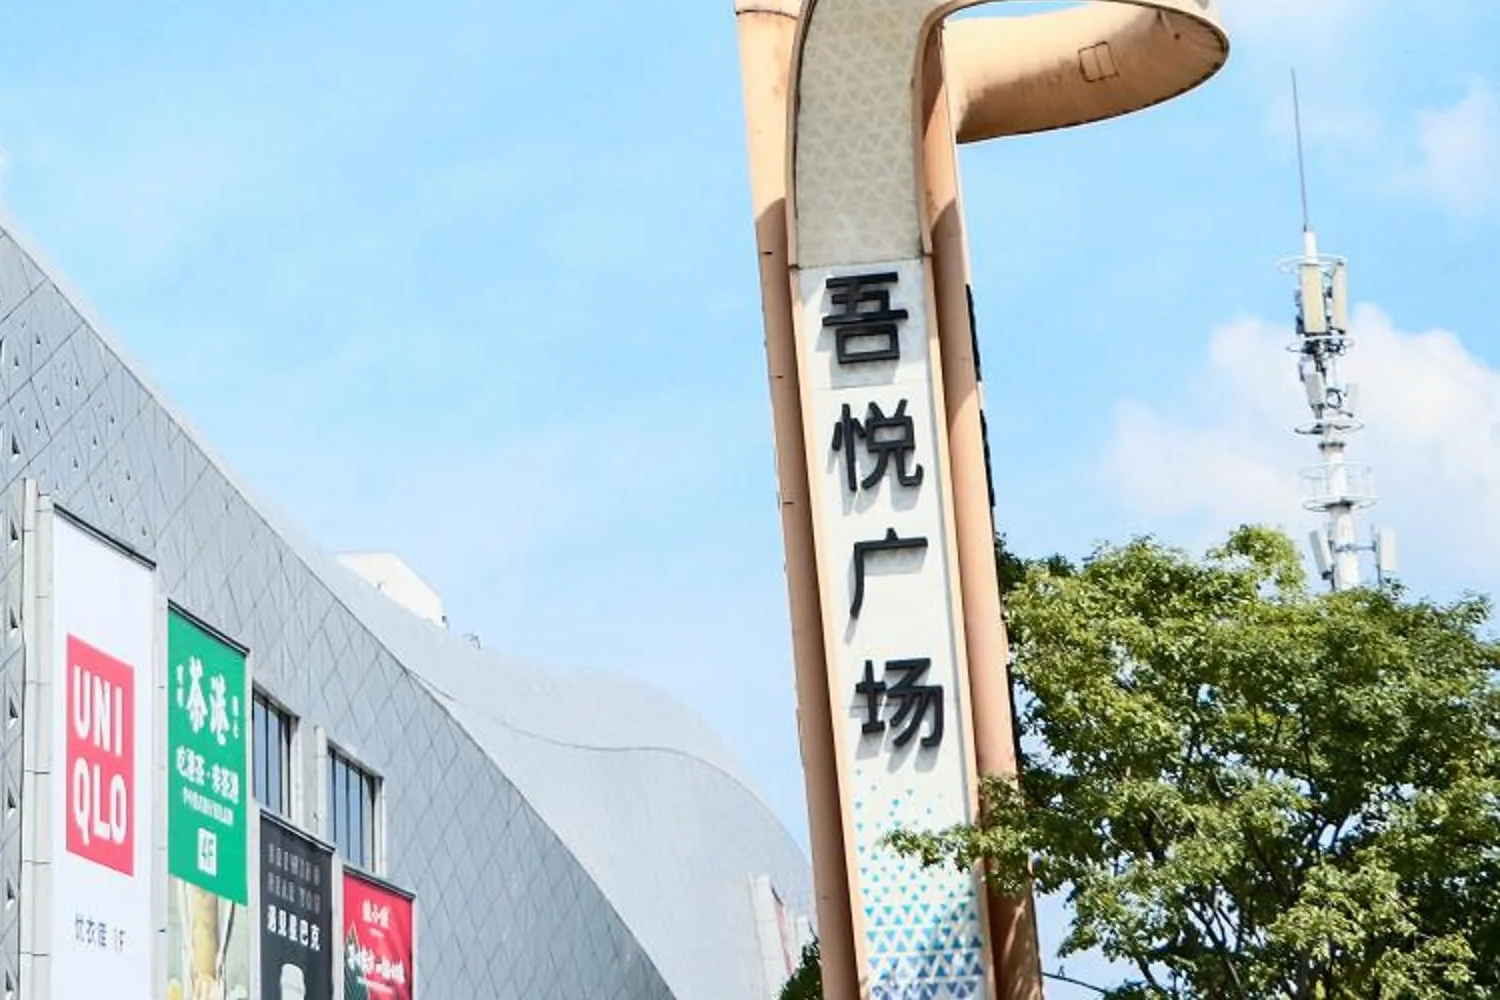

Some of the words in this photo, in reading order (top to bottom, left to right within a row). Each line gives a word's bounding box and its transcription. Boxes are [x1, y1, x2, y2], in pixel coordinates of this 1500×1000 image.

[822, 271, 944, 748] 吾悦广场
[73, 665, 123, 757] UNI
[73, 758, 127, 846] QLO
